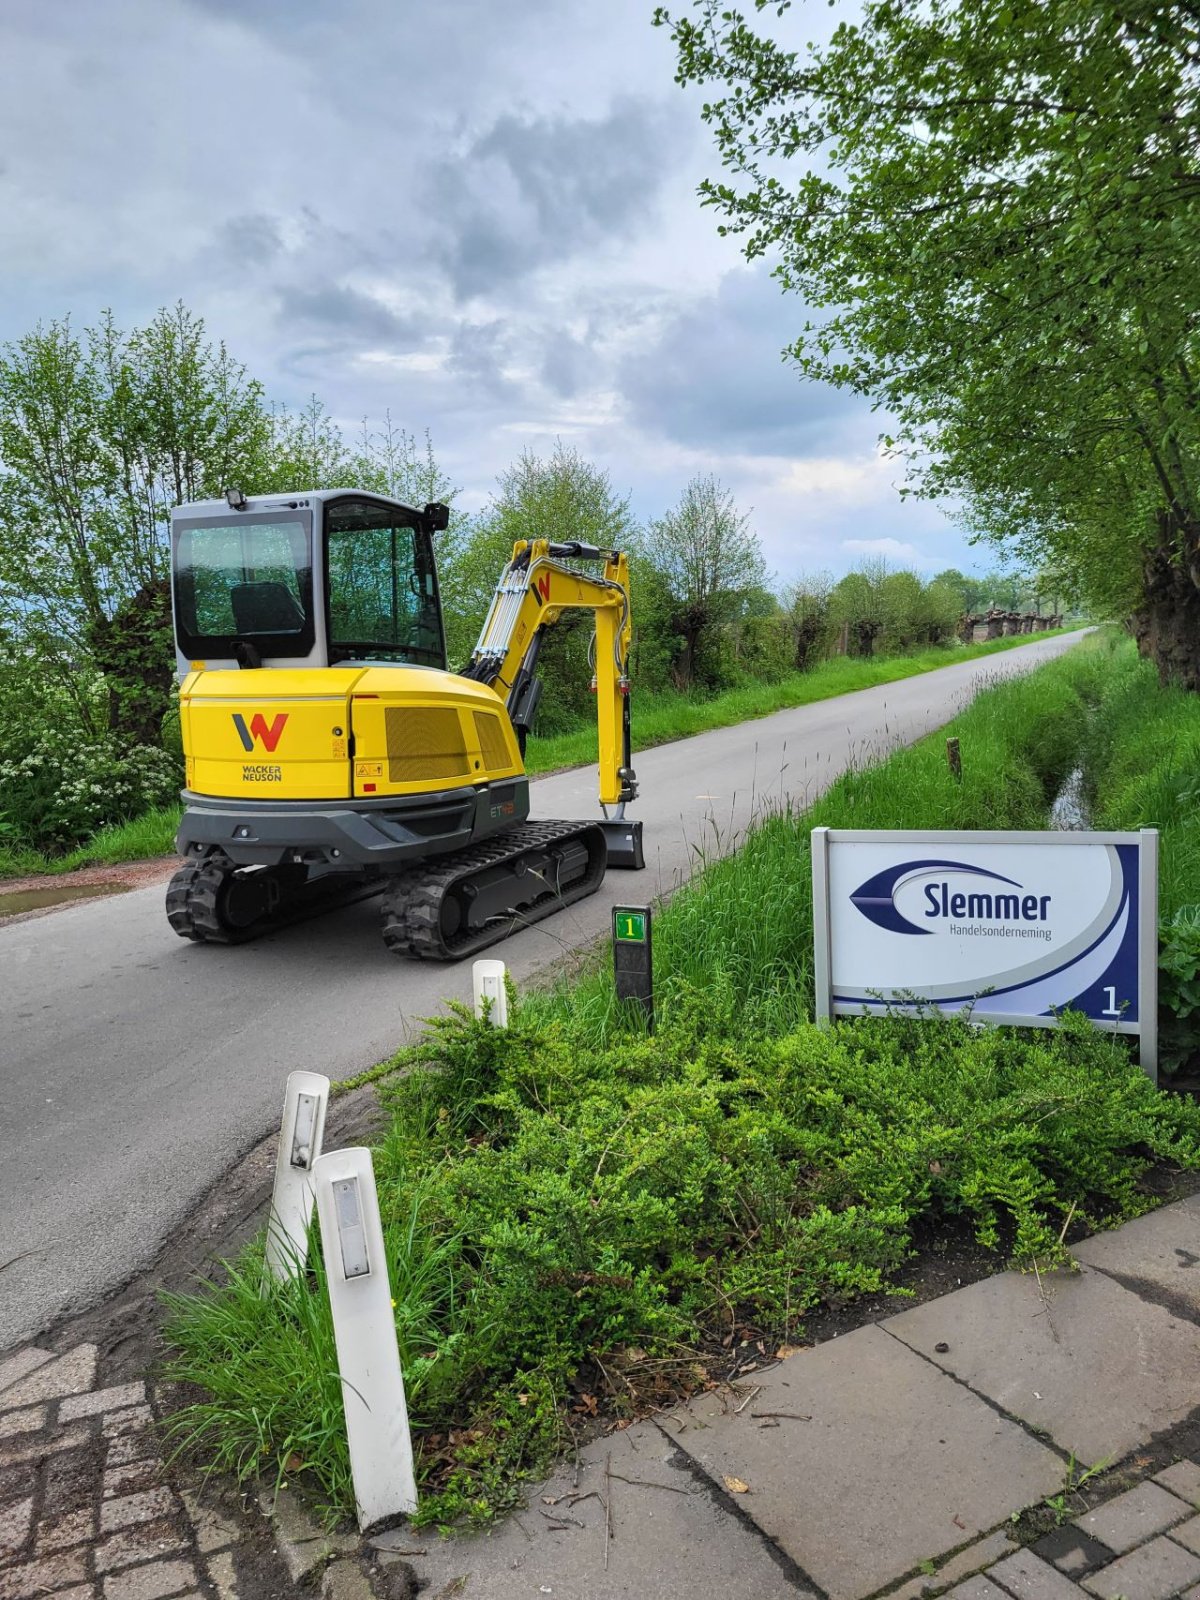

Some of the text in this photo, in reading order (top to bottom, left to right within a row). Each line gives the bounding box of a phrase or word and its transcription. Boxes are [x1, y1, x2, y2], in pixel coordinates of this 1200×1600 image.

[242, 765, 281, 774] WACKER
[242, 773, 282, 782] NEUSON
[924, 882, 1052, 921] Slemmer
[625, 918, 635, 936] 1
[949, 923, 1052, 941] Handelsonderneming
[1102, 986, 1121, 1015] 1
